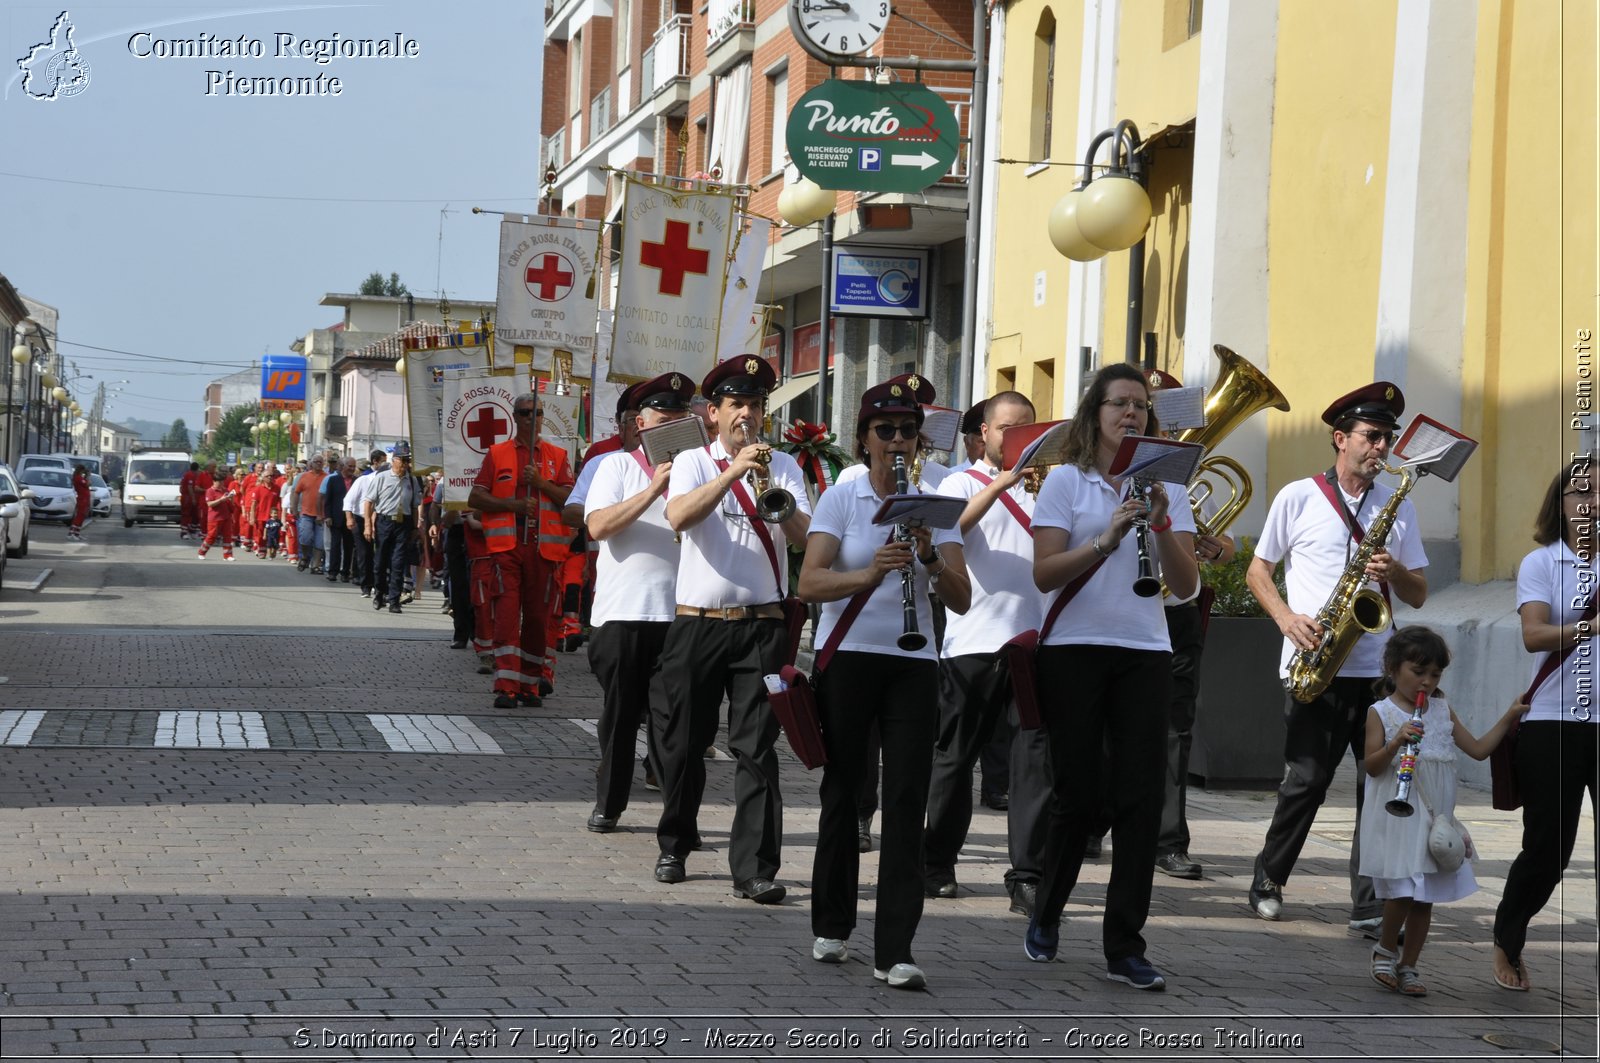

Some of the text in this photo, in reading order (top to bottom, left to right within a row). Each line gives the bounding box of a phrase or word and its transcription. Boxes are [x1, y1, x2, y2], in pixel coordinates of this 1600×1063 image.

[879, 2, 888, 17] 3
[840, 36, 848, 51] 6
[804, 99, 900, 135] Punto
[804, 146, 853, 154] PARCHEGGIO
[807, 153, 849, 161] RISERVATO
[862, 150, 879, 169] P
[818, 160, 848, 168] CLIENTI
[631, 195, 657, 222] CROCE
[693, 199, 727, 233] ITALIANA
[507, 233, 593, 276] CROCE ROSSA ITALIANA
[531, 308, 566, 321] GRUPPO
[618, 305, 718, 331] COMITATO LOCALE
[497, 328, 593, 347] VILLAFRANCA D'ASTI
[626, 330, 705, 353] SAN DAMIANO
[266, 371, 302, 391] IP
[446, 386, 516, 430] CROCE ROSSA ITAL
[464, 467, 481, 475] COMIT
[449, 478, 474, 487] MONTE
